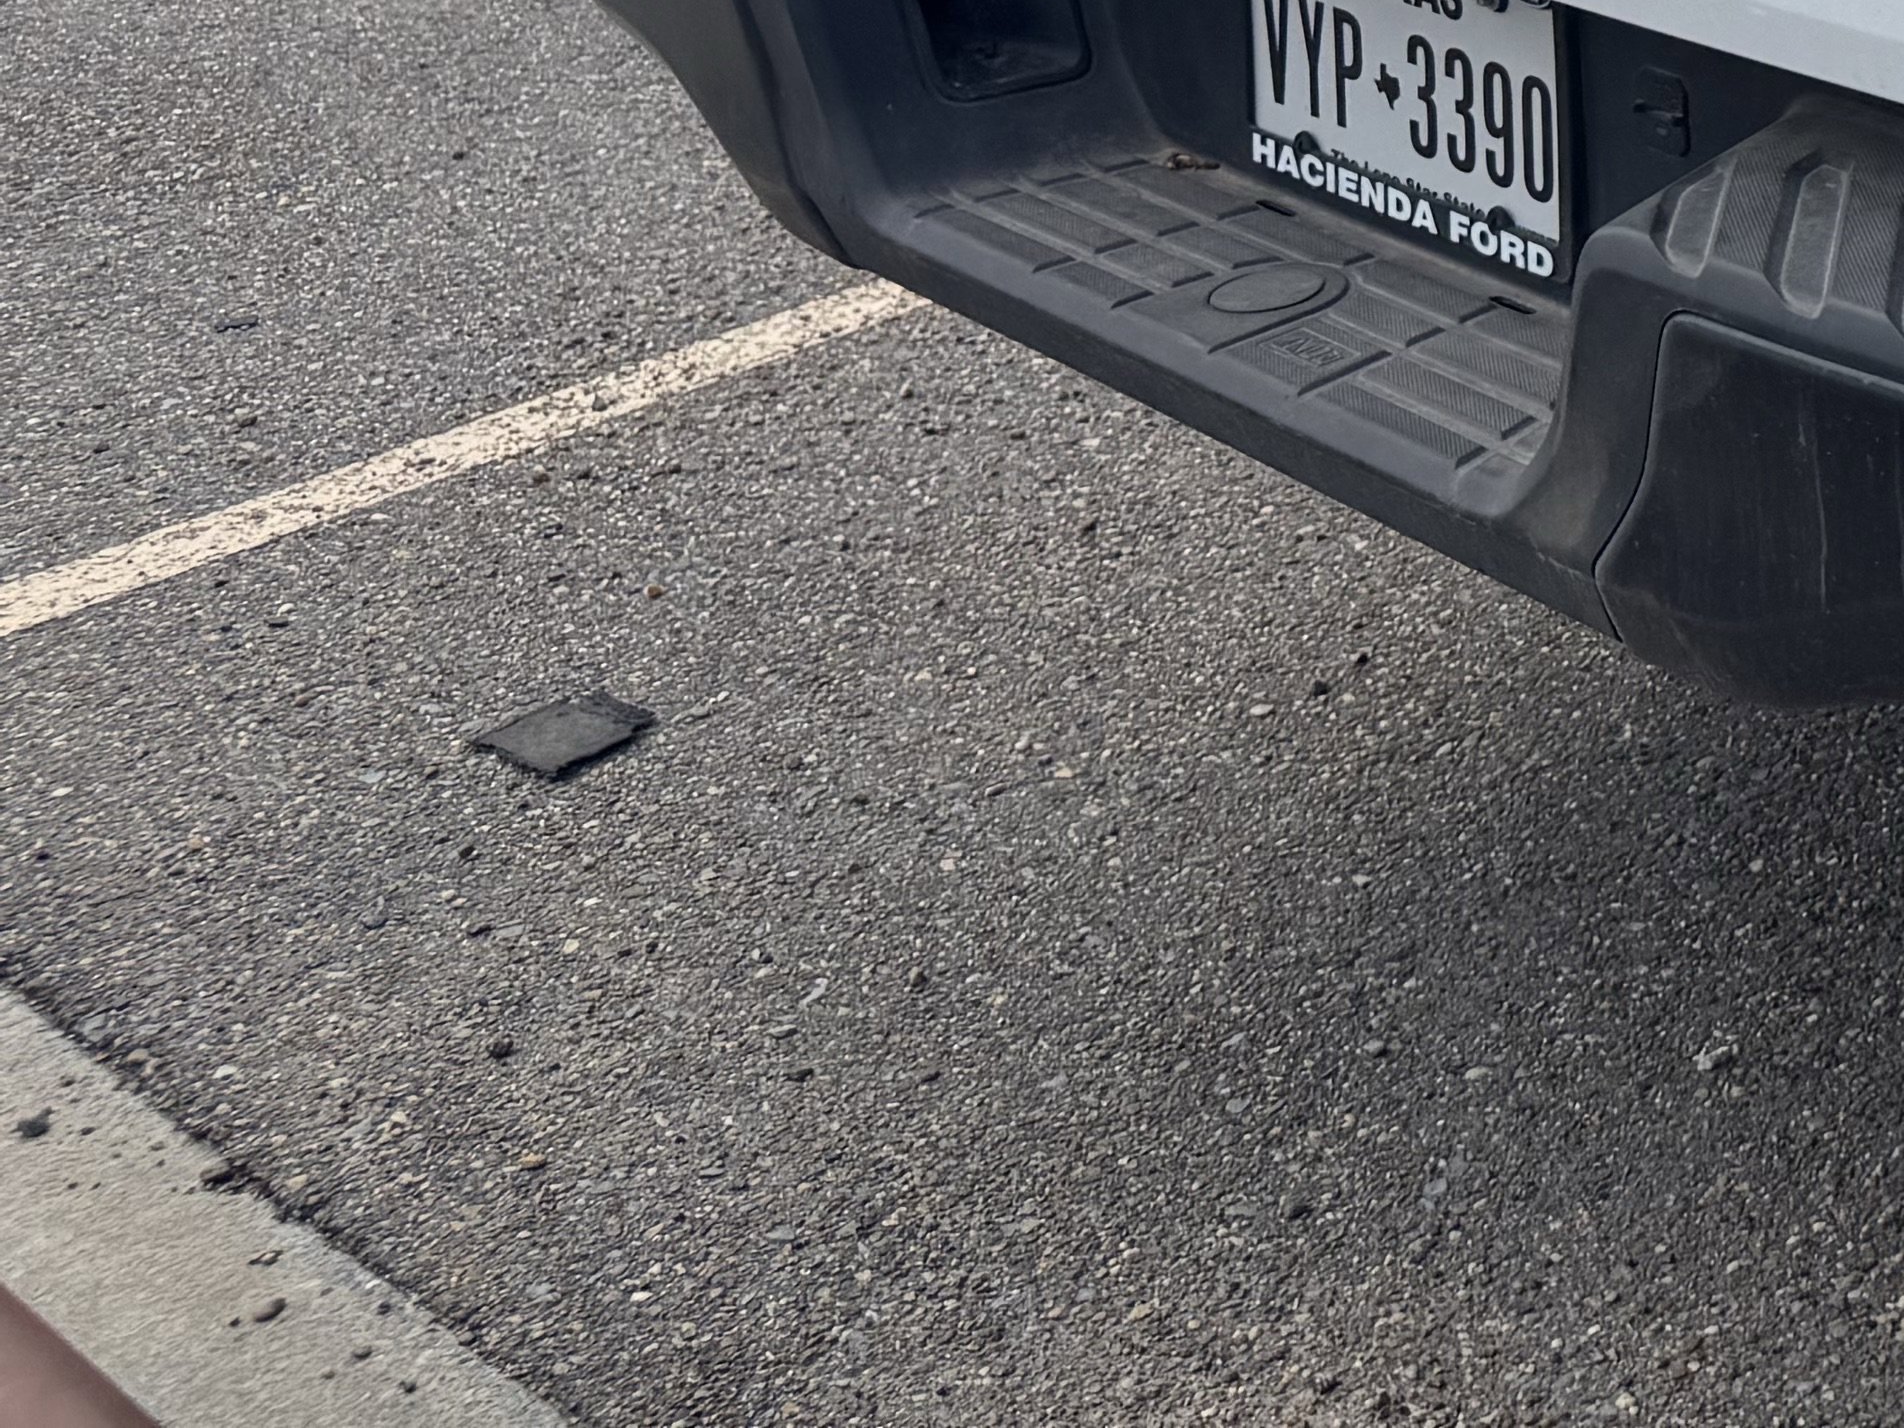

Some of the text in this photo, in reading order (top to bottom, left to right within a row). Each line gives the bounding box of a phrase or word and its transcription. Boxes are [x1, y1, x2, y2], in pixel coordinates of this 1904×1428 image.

[1405, 33, 1556, 204] 3390
[1251, 131, 1556, 280] HACIENDA FORD
